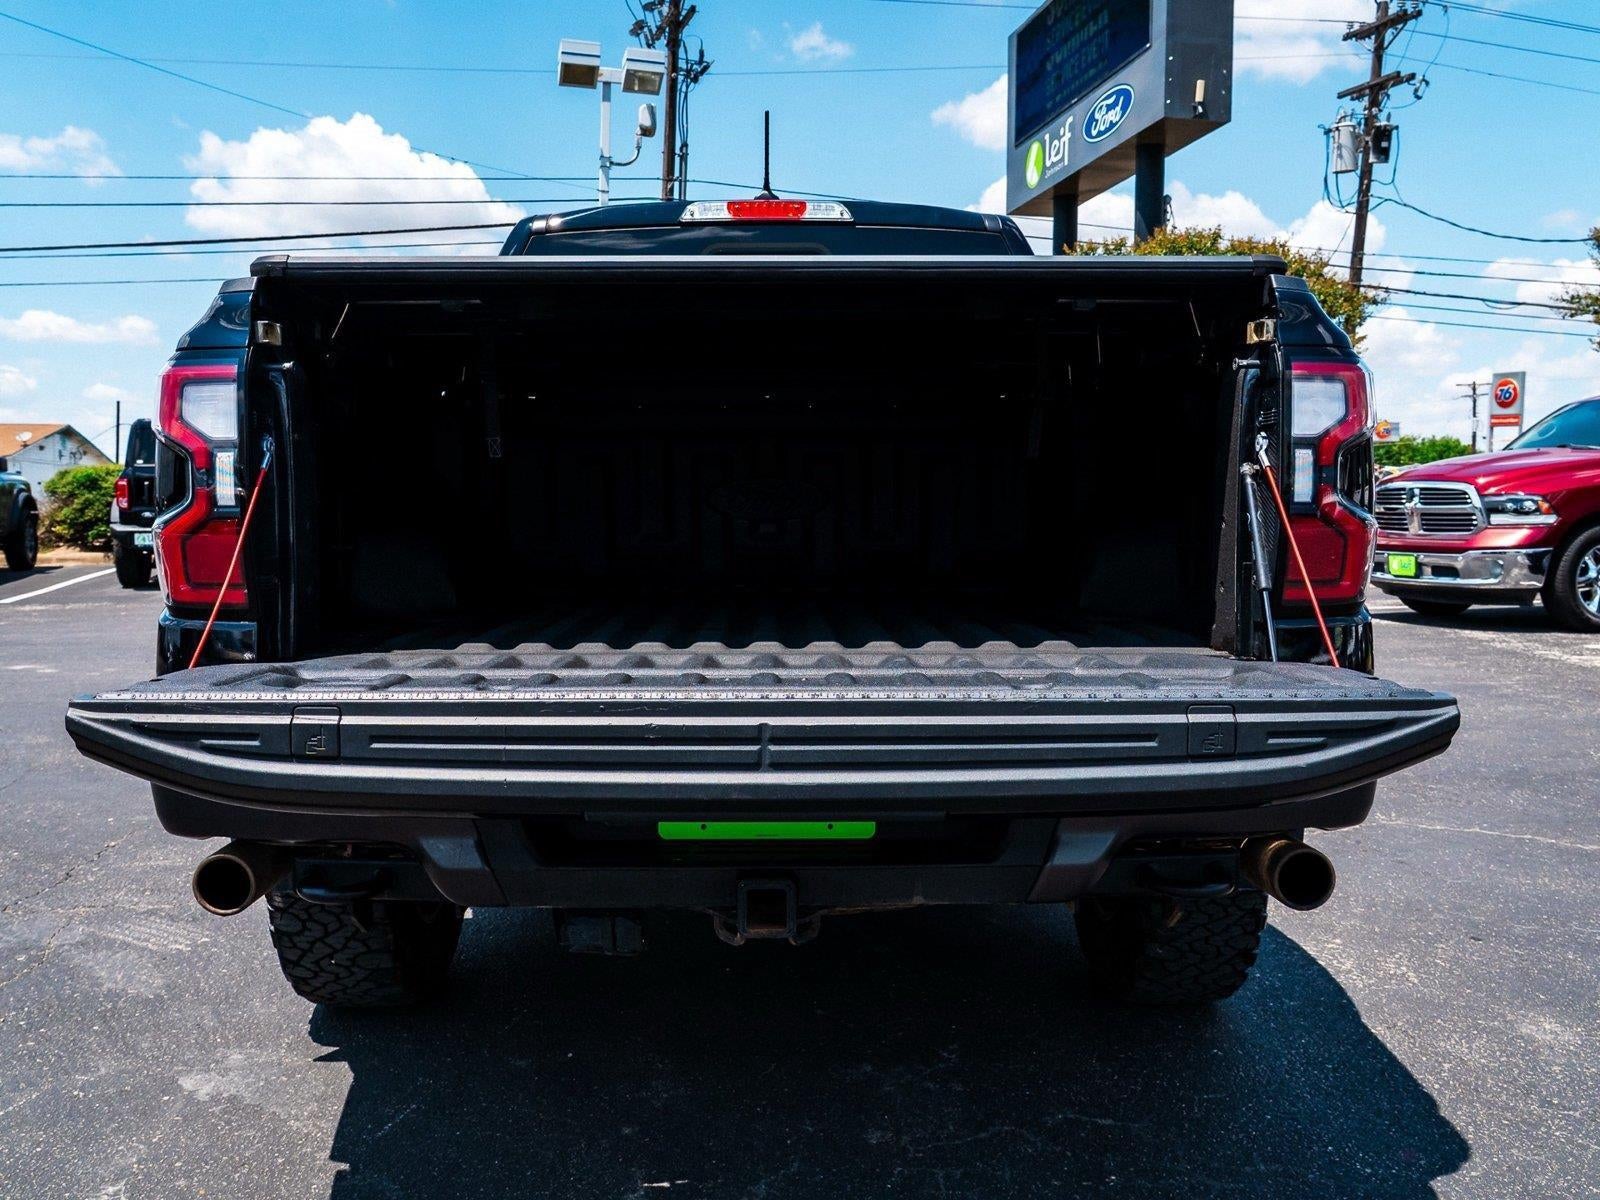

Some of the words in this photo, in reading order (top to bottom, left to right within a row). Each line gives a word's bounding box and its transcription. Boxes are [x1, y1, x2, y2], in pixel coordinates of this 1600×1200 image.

[1091, 94, 1124, 137] Ford
[1044, 115, 1074, 168] leif
[1496, 384, 1515, 402] 76
